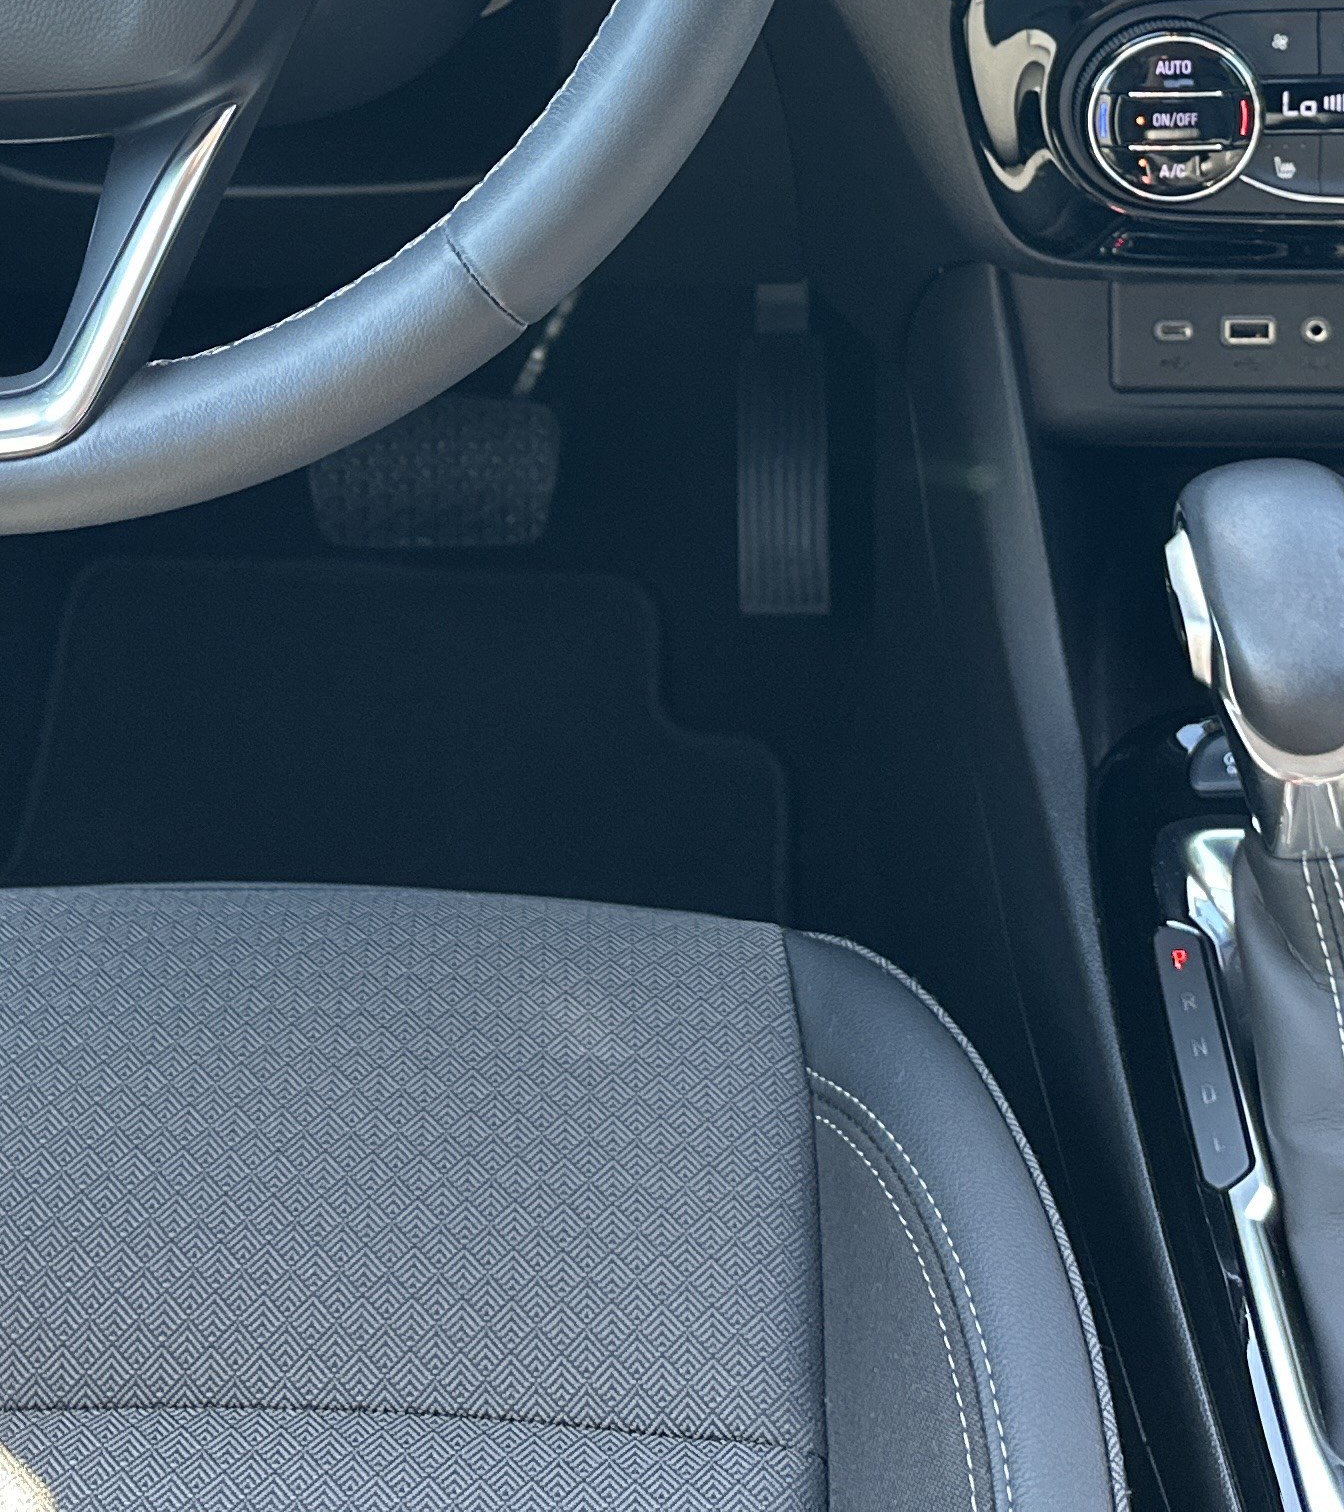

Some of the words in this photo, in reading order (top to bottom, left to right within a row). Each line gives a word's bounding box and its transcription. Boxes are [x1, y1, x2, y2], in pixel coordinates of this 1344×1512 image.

[1155, 59, 1192, 76] AUTO
[1282, 90, 1317, 116] Lo
[1152, 111, 1199, 128] ON/OFF
[1159, 162, 1187, 179] A/C
[1170, 949, 1188, 970] P
[1180, 991, 1198, 1013] R
[1190, 1037, 1209, 1058] N
[1200, 1084, 1218, 1105] D
